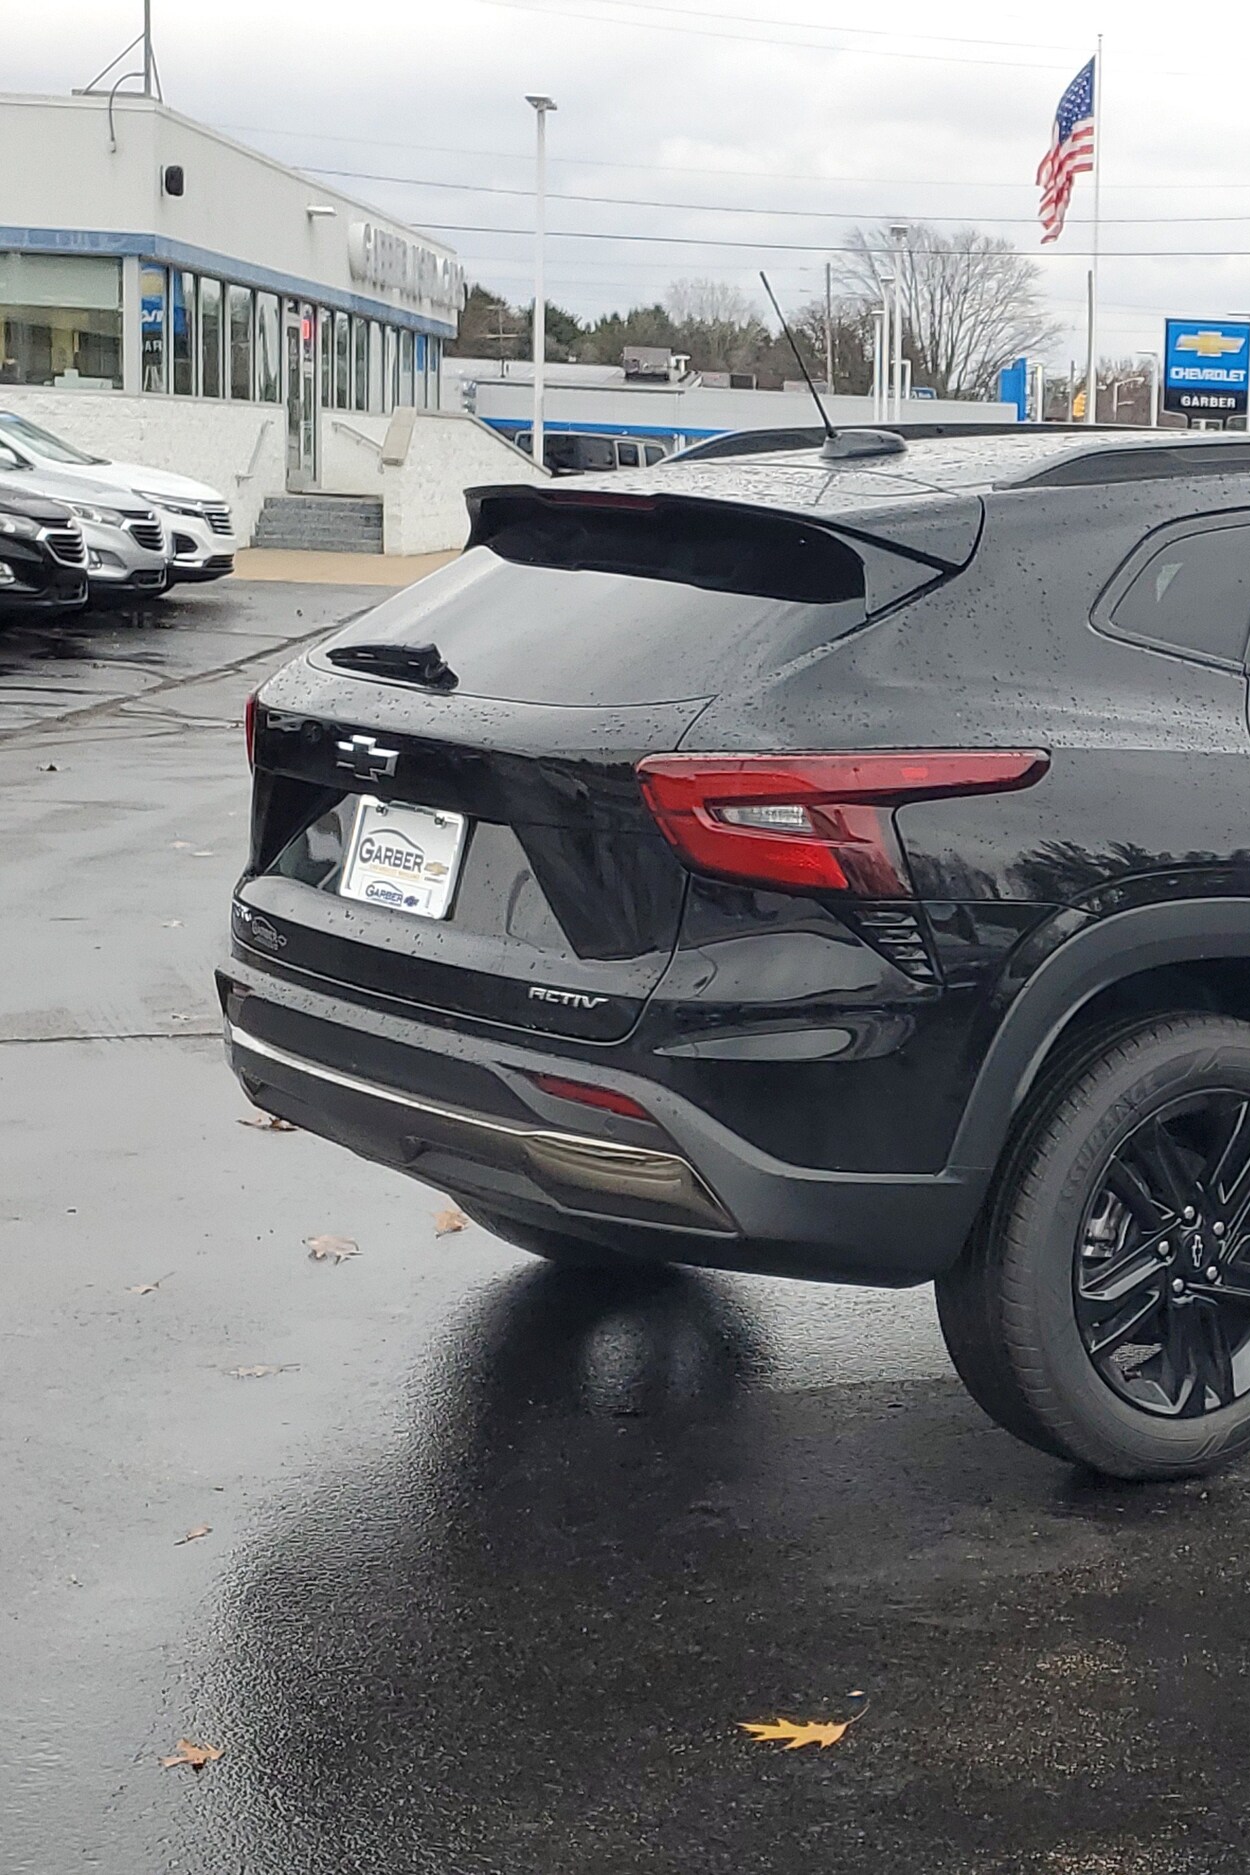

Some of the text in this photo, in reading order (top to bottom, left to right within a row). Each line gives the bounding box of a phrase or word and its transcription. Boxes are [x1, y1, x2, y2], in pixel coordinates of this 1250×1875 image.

[1170, 367, 1246, 382] CHEVROLET
[1181, 396, 1236, 409] GARBER
[359, 837, 425, 874] GARBER
[365, 884, 404, 903] GARBER
[528, 986, 610, 1009] ACTIV
